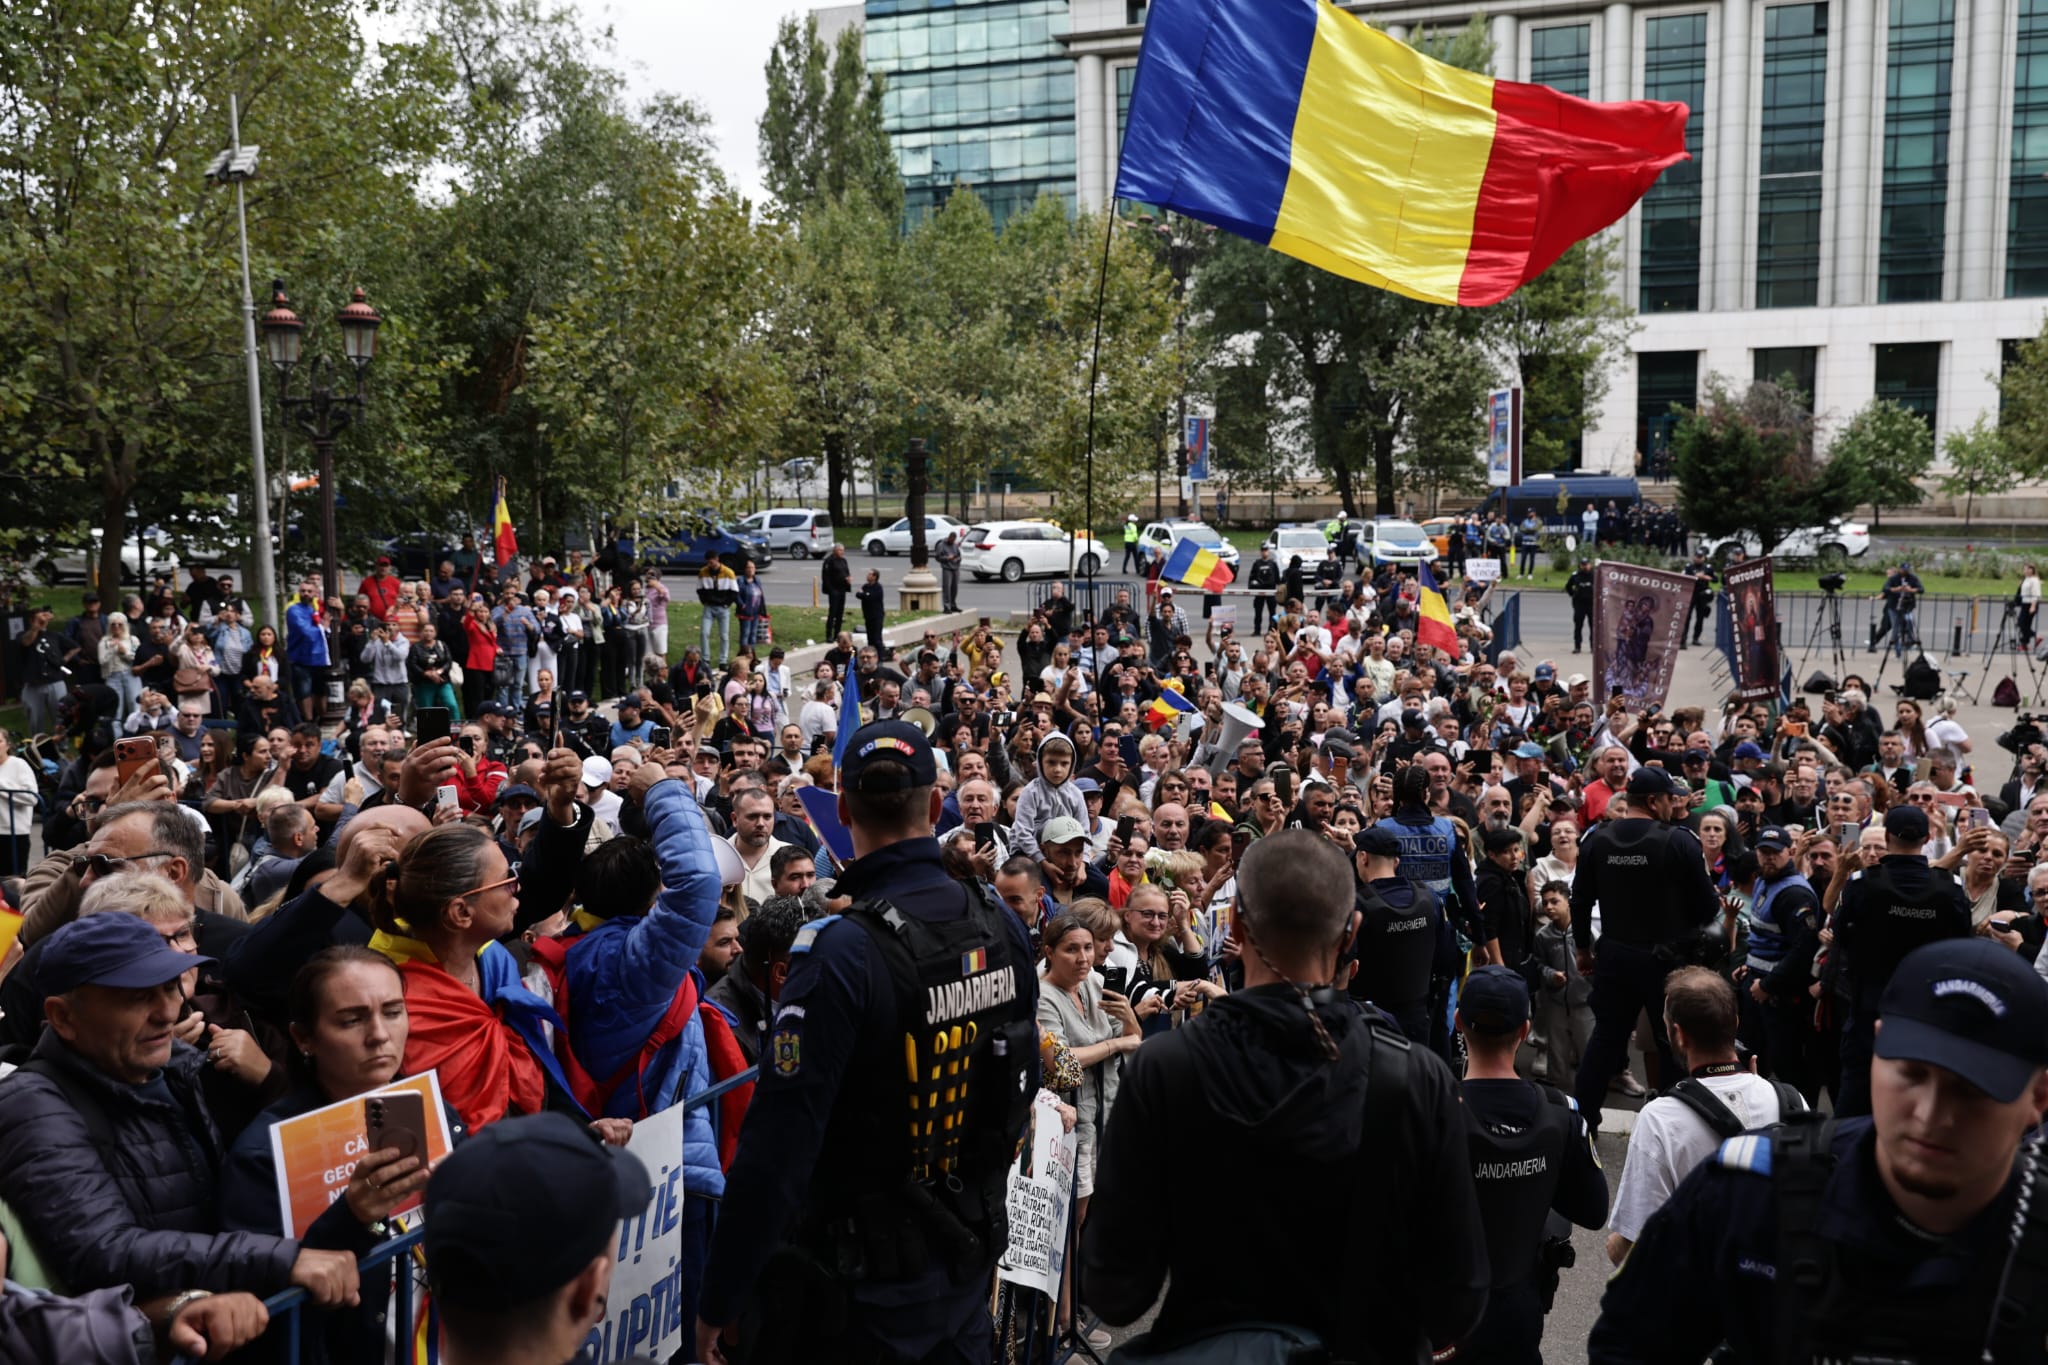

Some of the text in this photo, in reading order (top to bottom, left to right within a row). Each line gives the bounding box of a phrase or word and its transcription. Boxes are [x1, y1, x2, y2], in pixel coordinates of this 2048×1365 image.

[1608, 571, 1682, 593] ORTODOX
[1654, 601, 1683, 696] SACRIFICIU
[1387, 916, 1428, 933] JANDARMERIA
[926, 965, 1017, 1025] JANDARMERIA
[1706, 1064, 1736, 1074] Canon
[1475, 1155, 1547, 1179] JANDARMERIA
